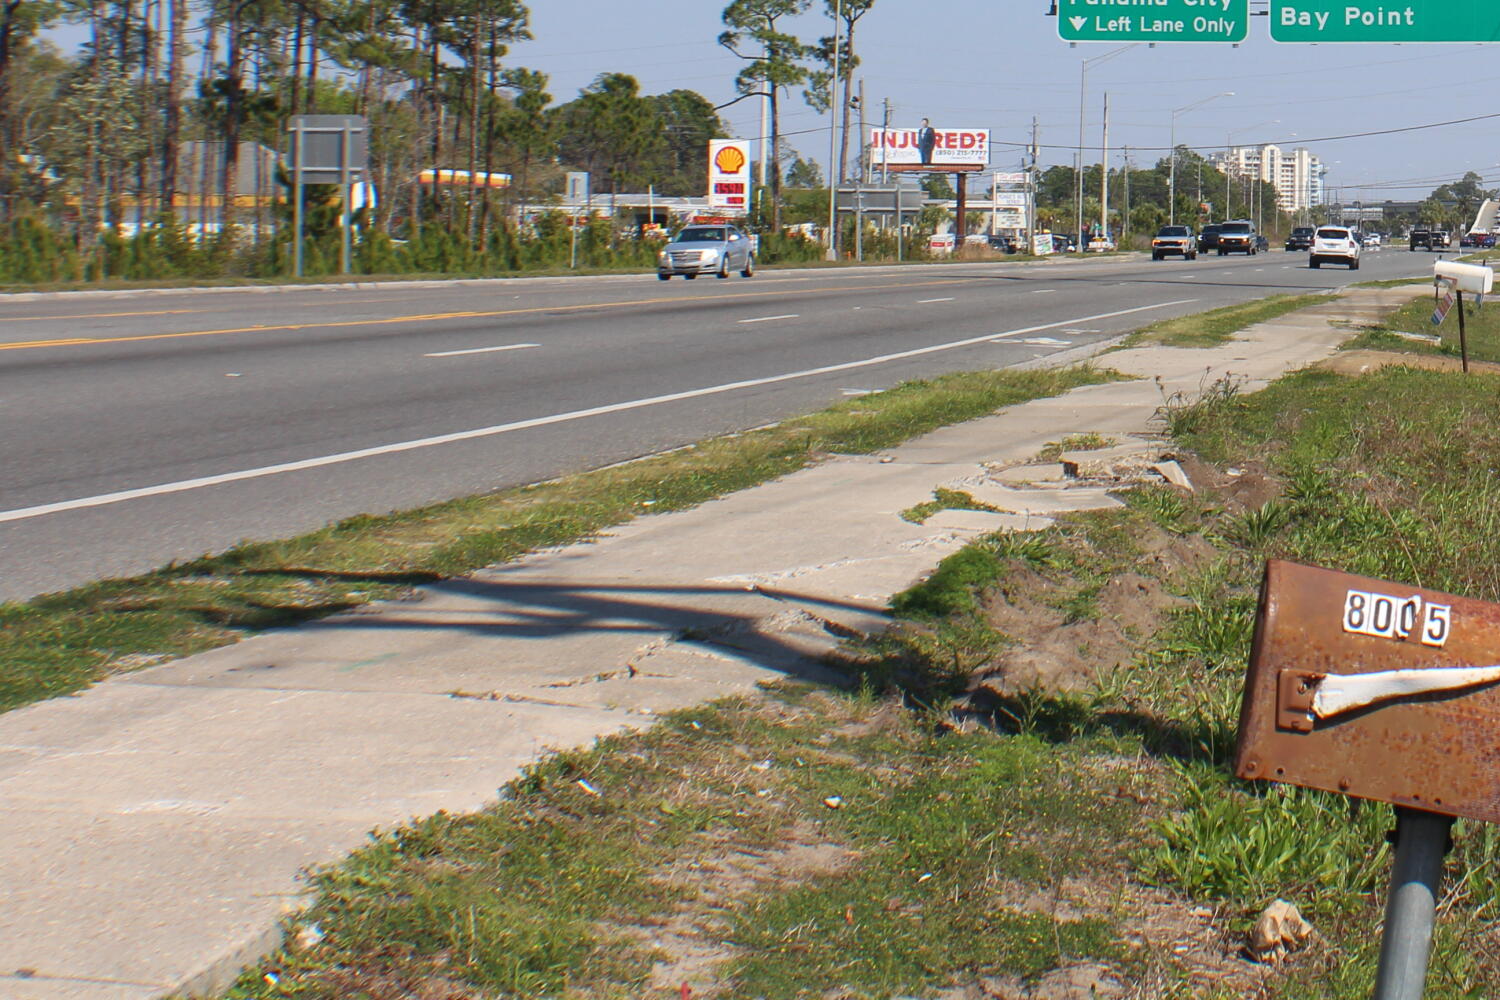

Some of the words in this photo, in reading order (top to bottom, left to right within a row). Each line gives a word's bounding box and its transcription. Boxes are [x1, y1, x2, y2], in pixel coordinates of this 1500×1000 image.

[1095, 16, 1131, 32] Left
[1140, 17, 1184, 32] Lane
[1193, 17, 1235, 36] Only
[1281, 7, 1330, 30] Bay
[1345, 7, 1415, 26] Point
[871, 131, 986, 149] INJURED?
[1347, 594, 1447, 641] 8005
